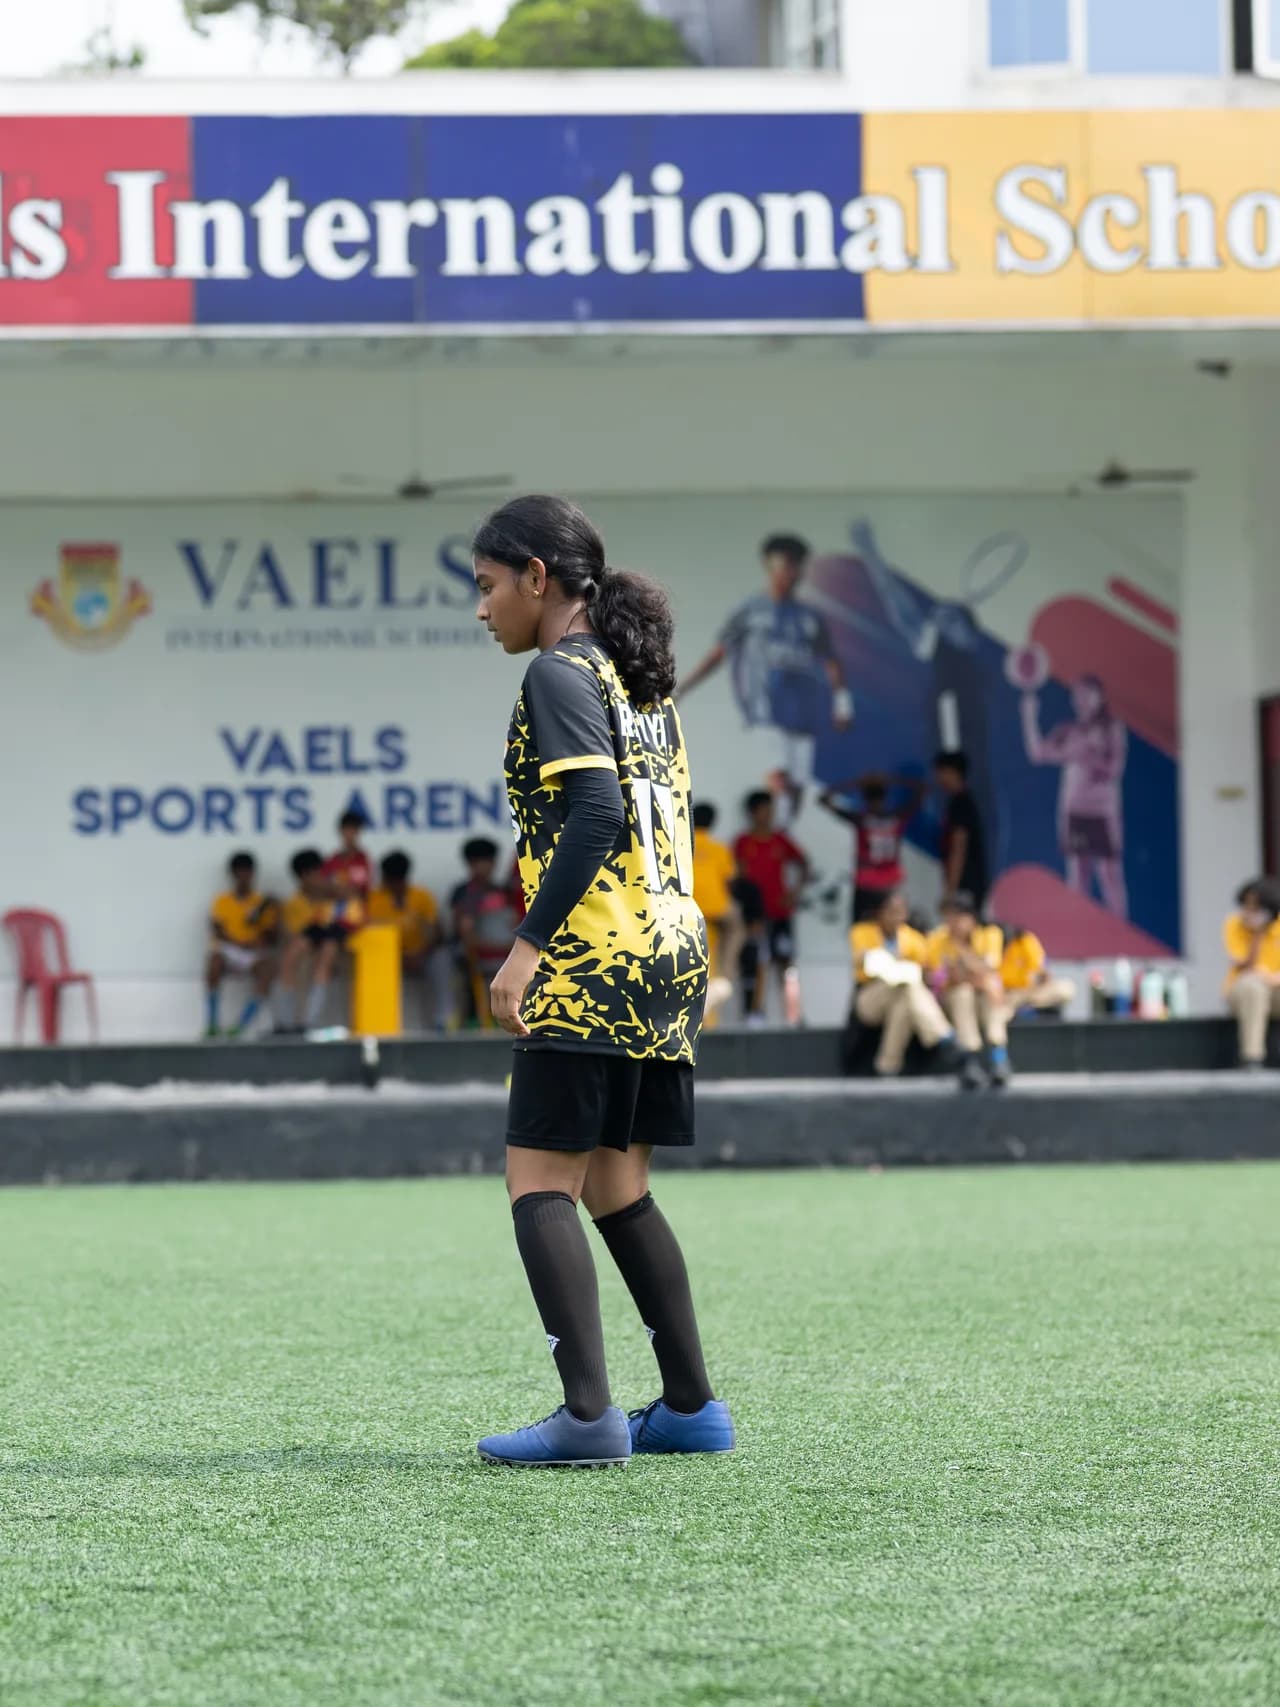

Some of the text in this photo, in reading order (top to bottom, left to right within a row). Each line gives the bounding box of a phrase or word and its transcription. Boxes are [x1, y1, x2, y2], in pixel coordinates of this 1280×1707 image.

[105, 162, 958, 280] International
[994, 164, 1280, 275] Scho
[176, 535, 478, 610] VAELS
[219, 725, 407, 774] VAELS
[72, 785, 313, 834] SPORTS
[341, 782, 504, 830] AREN
